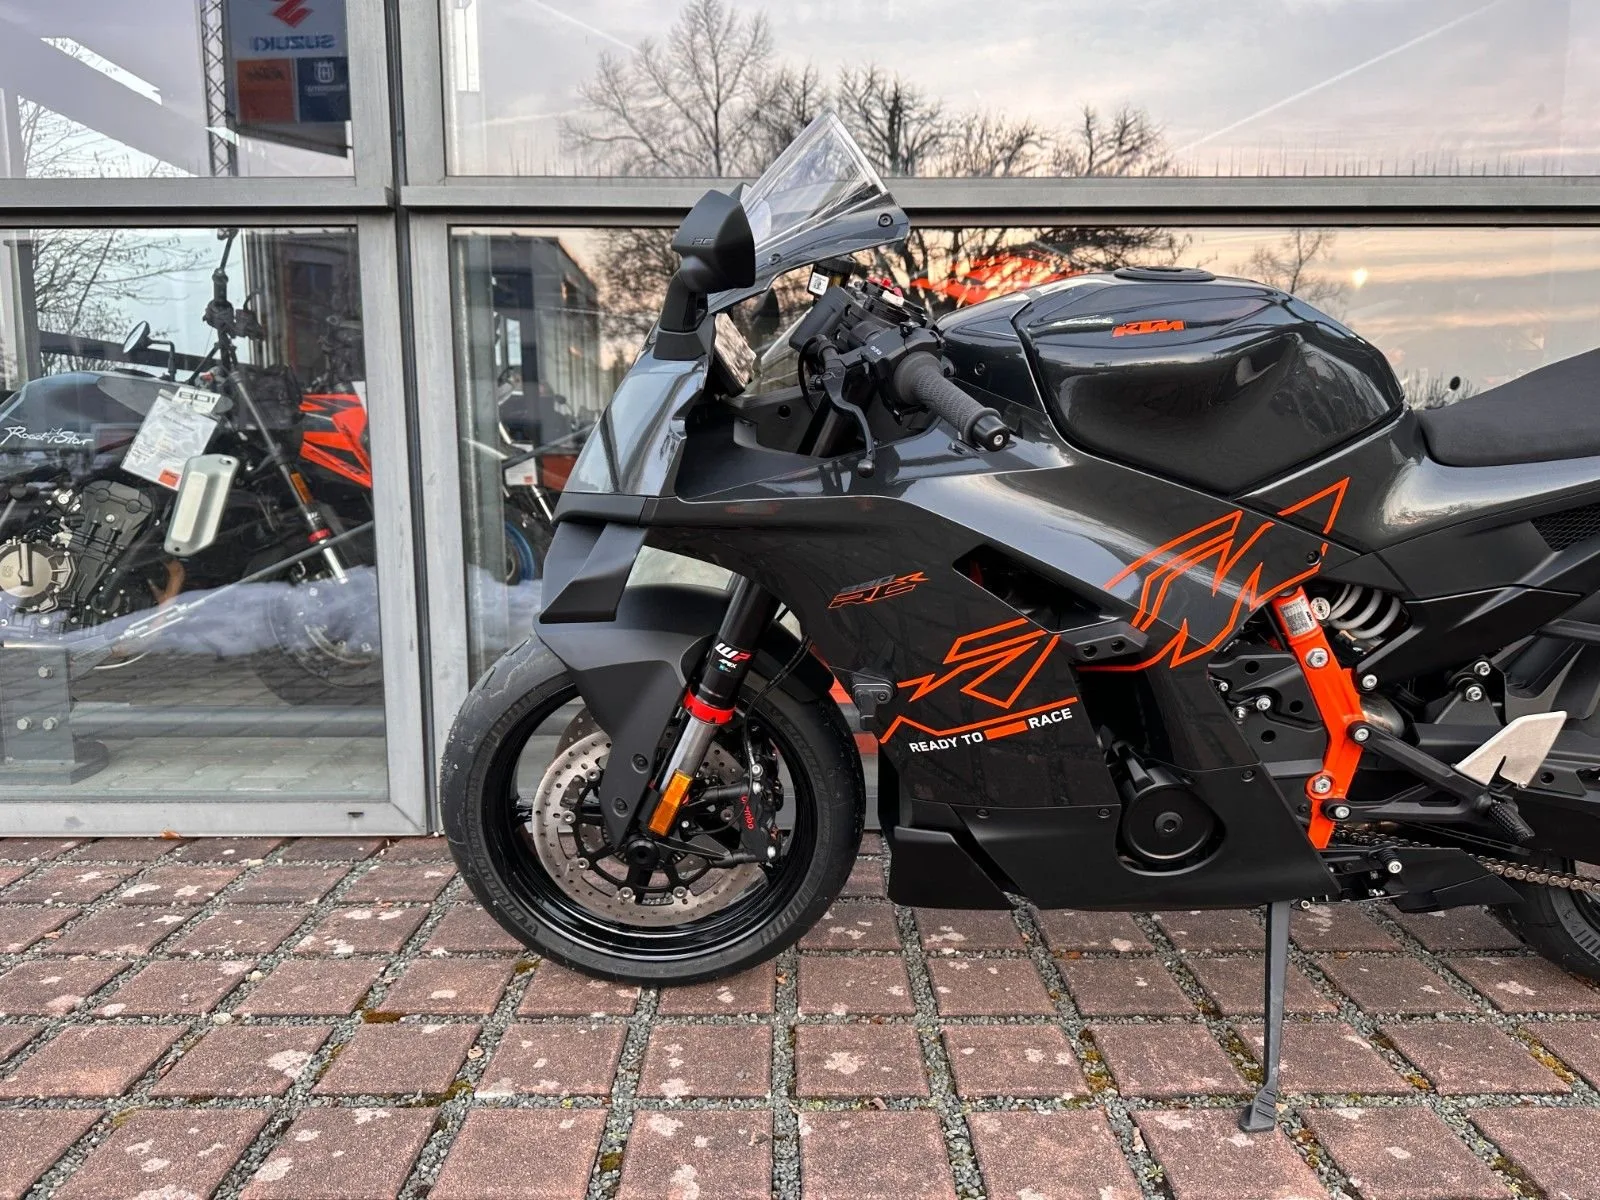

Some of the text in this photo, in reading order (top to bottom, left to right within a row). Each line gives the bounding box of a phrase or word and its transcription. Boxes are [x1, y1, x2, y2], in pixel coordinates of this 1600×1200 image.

[1111, 319, 1185, 338] KTM
[908, 708, 1073, 753] READY TO RACE
